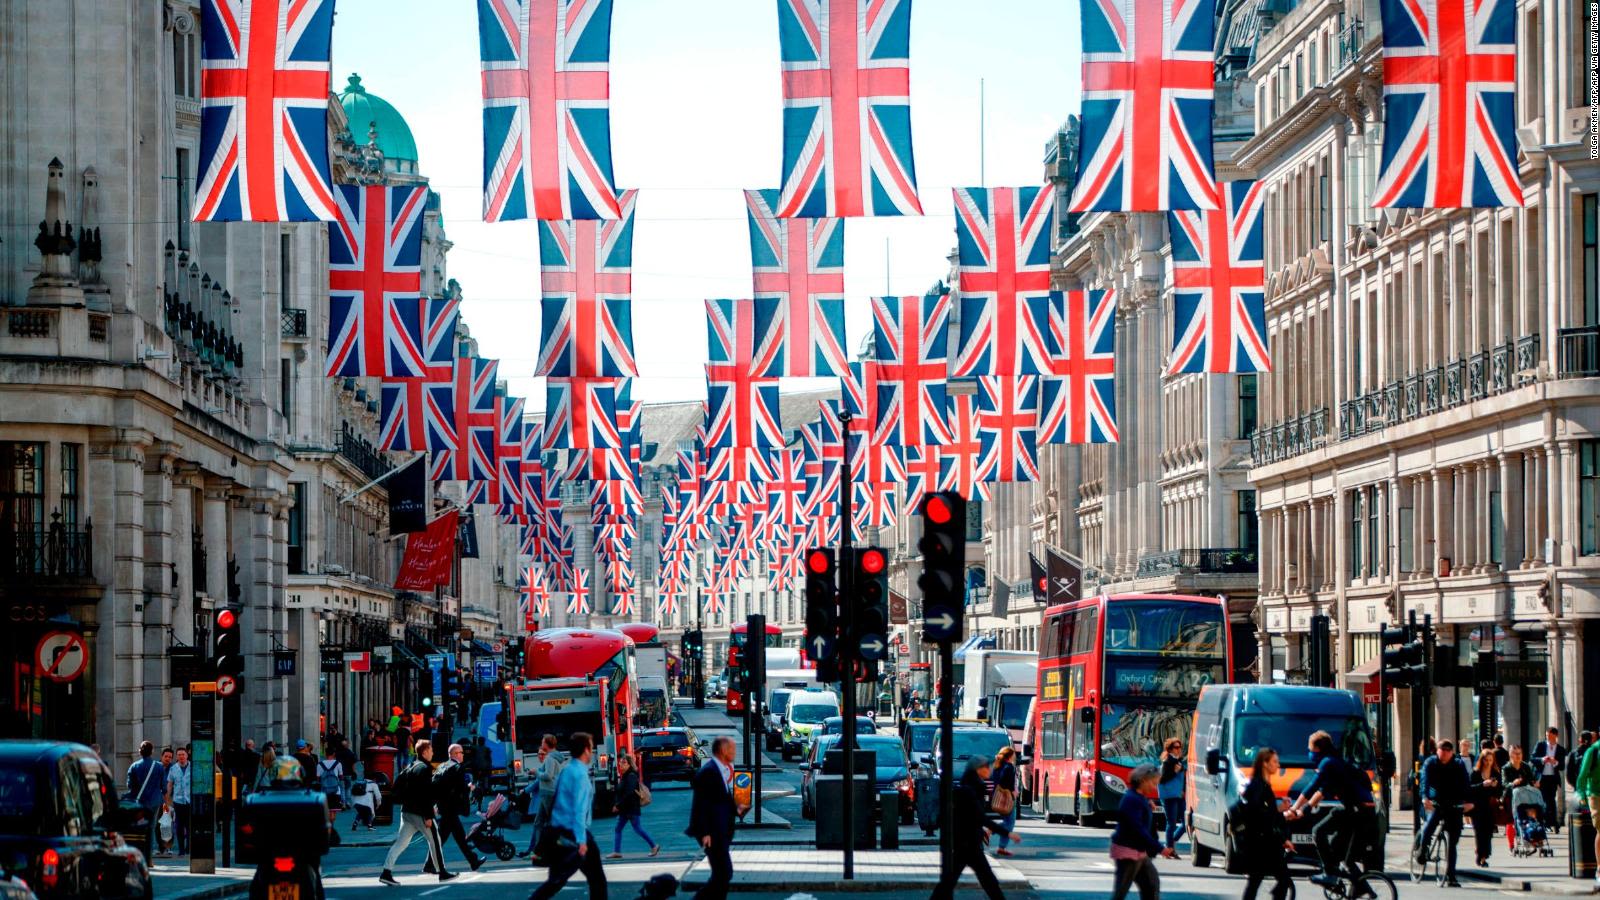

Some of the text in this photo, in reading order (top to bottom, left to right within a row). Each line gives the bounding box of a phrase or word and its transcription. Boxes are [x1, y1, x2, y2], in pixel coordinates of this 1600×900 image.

[9, 606, 46, 622] COS
[278, 659, 292, 671] GAP
[1120, 673, 1172, 684] Oxford Circu
[1501, 667, 1544, 678] FURLA
[1191, 672, 1209, 688] 22
